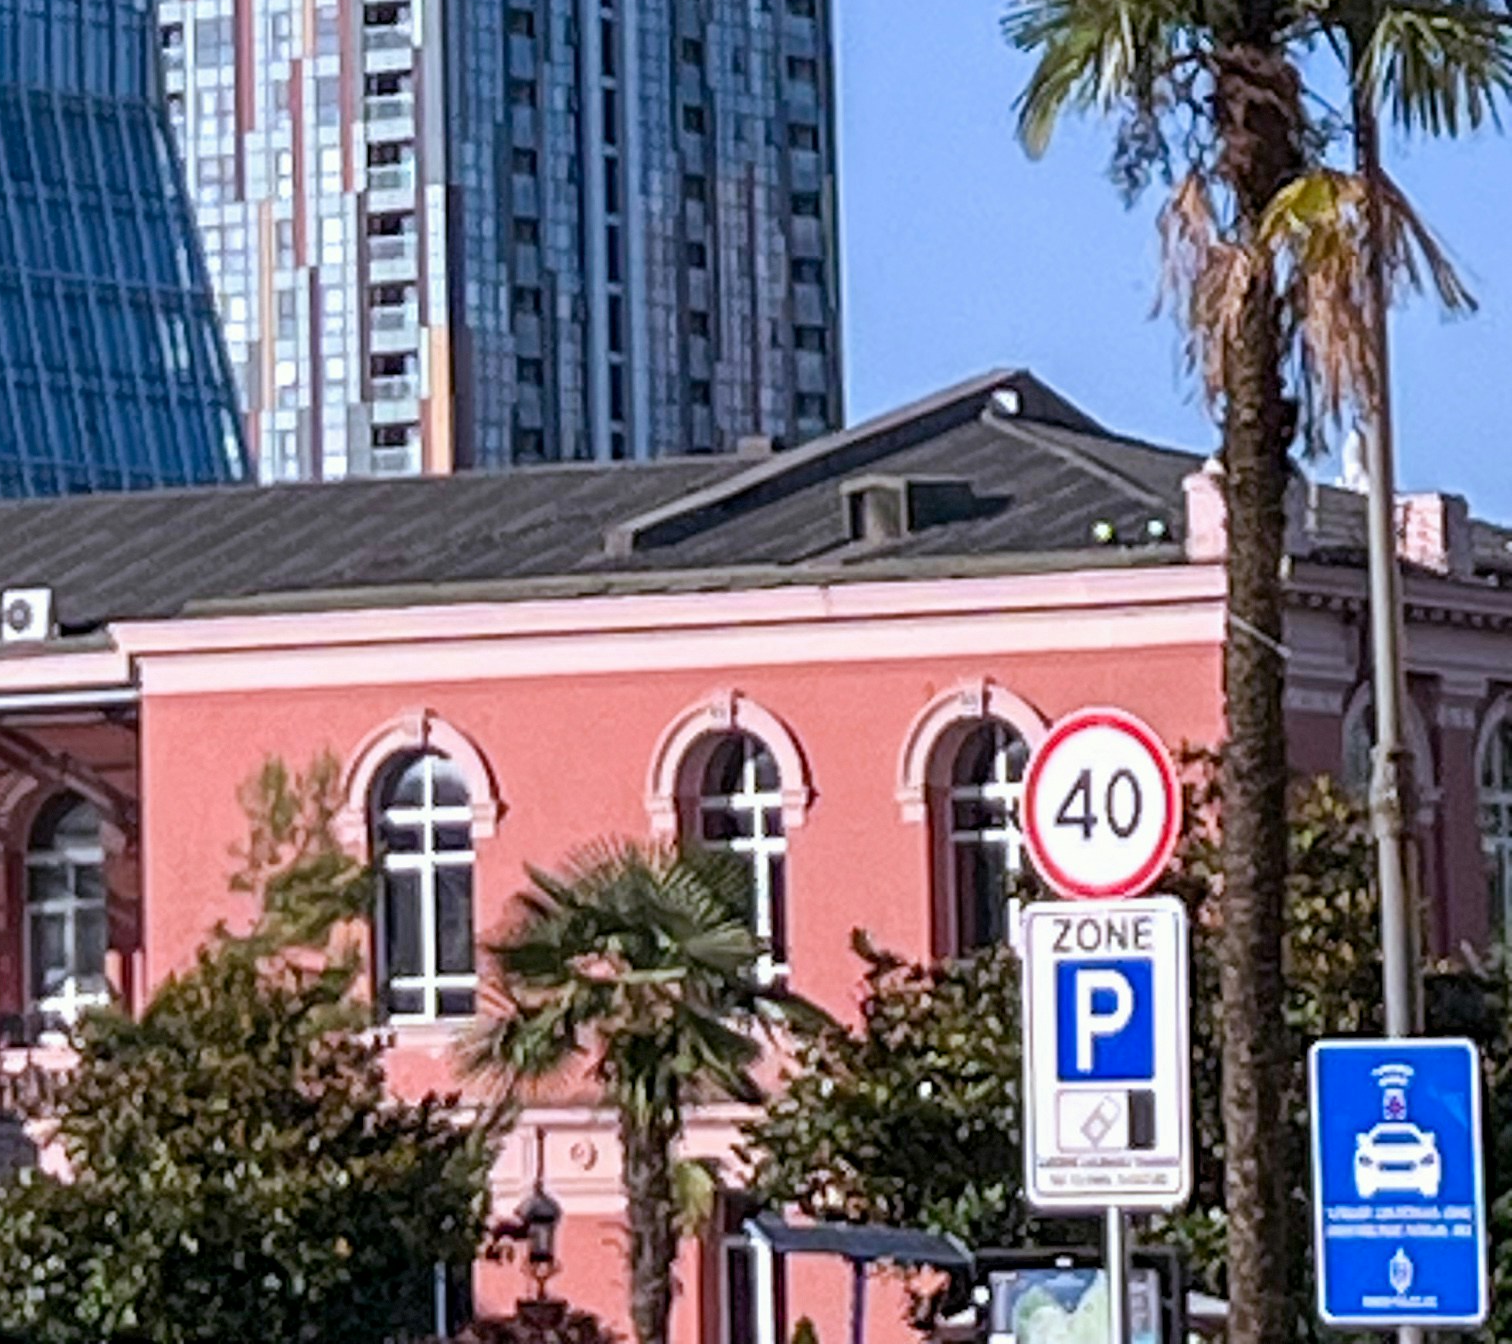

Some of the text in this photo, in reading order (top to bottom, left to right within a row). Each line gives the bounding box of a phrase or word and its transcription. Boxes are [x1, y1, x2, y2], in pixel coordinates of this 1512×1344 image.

[1054, 768, 1142, 840] 40
[1052, 916, 1155, 953] ZONE
[1076, 968, 1134, 1074] P
